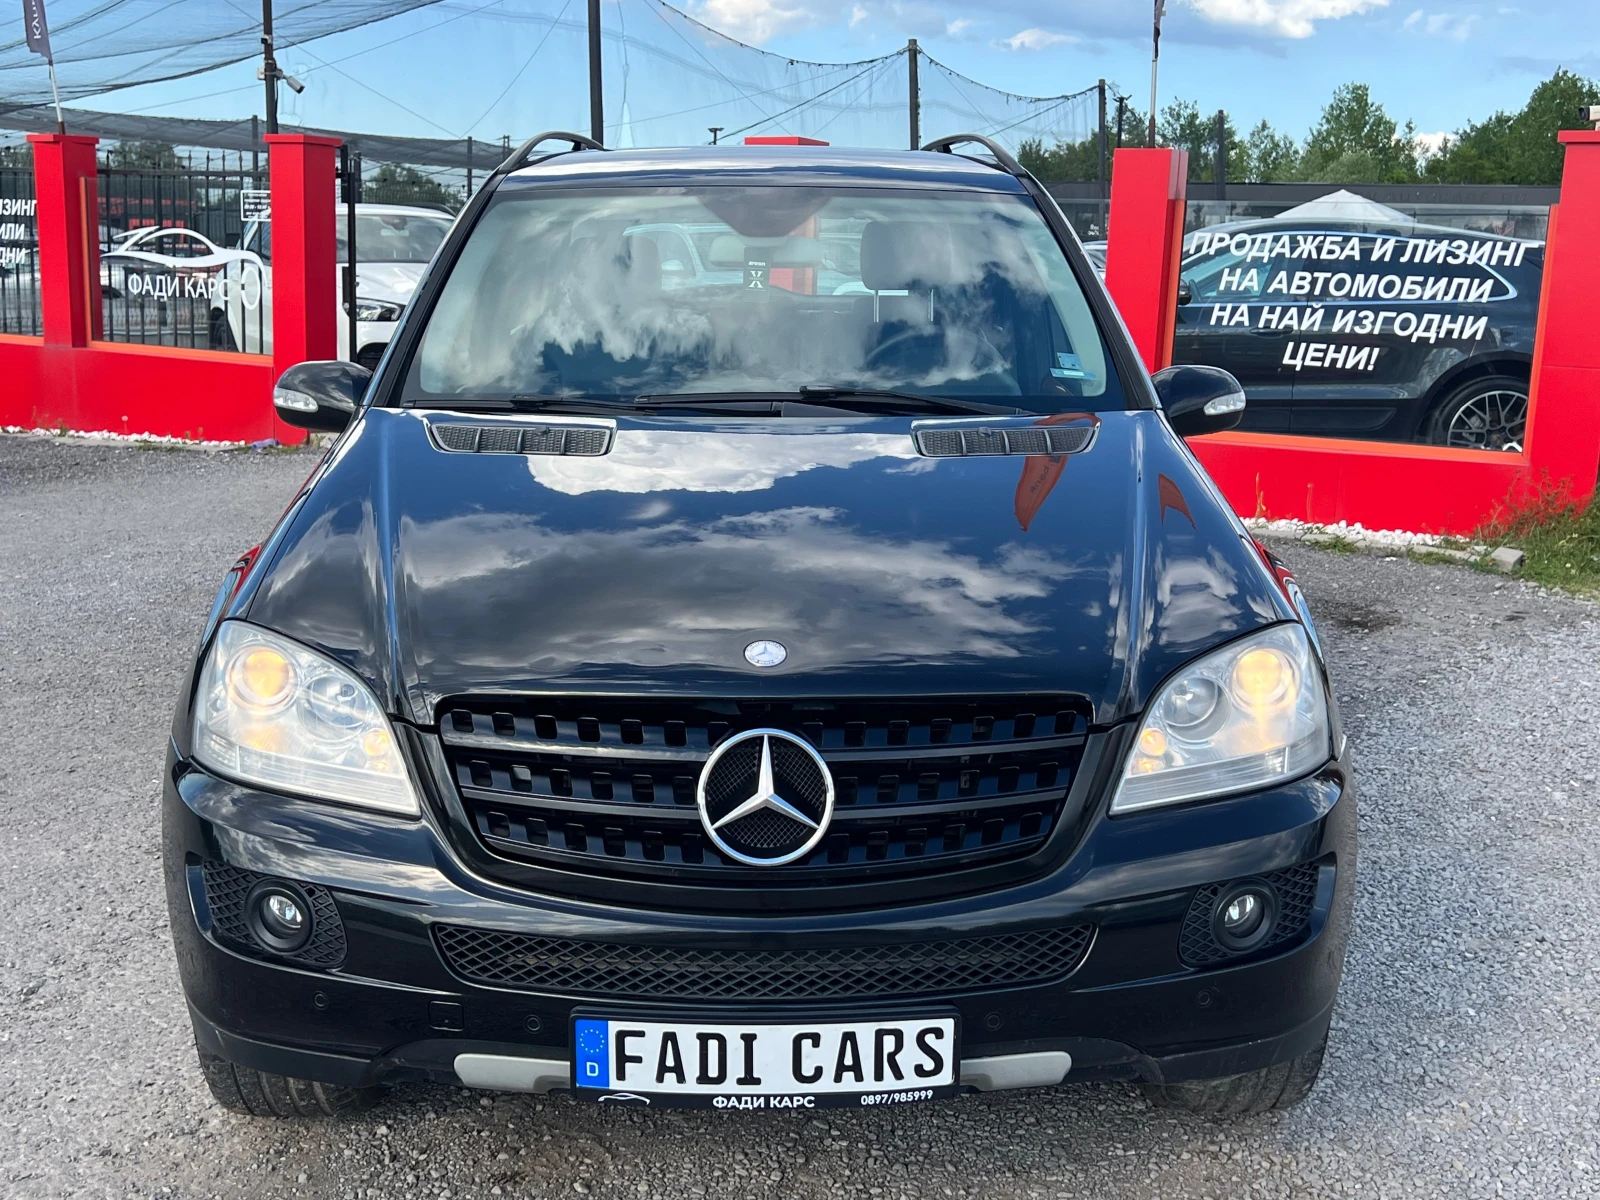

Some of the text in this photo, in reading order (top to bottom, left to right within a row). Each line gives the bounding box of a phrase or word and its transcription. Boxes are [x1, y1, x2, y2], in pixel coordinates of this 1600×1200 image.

[1189, 232, 1540, 266] ПРОДАЖБА И ЛИЗИНГ
[128, 273, 230, 301] ФАДИ КАРС
[1218, 268, 1494, 303] НА АВТОМОБИЛИ
[1209, 303, 1488, 344] НА НАЙ ИЗГОДНИ
[1282, 341, 1380, 371] ЦЕНИ!
[586, 1061, 599, 1077] D
[615, 1026, 945, 1086] FADI CARS
[712, 1095, 815, 1110] ФАДИ КАРС
[860, 1089, 934, 1105] 0897/985999
